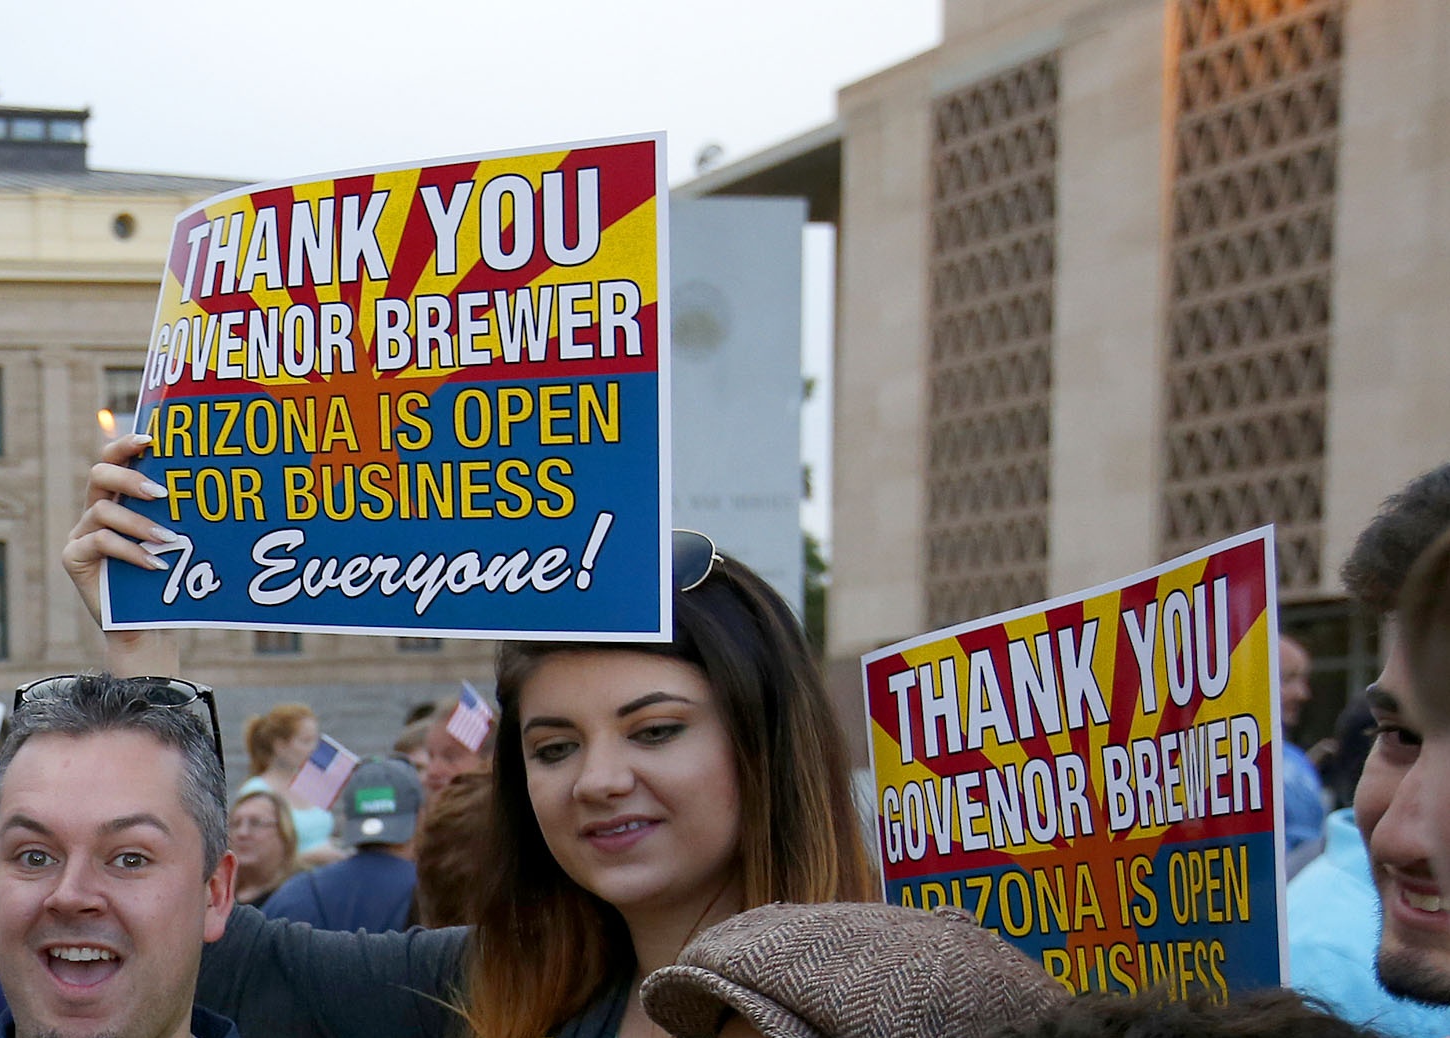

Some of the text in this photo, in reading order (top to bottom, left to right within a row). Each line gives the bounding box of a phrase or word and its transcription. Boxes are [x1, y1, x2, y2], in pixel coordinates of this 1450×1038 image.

[180, 166, 601, 305] THANK YOU
[147, 278, 644, 392] GOVENOR BREWER
[139, 381, 621, 460] ARIZONA IS OPEN
[164, 458, 576, 522] FOR BUSINESS
[139, 511, 614, 617] To Everyone!
[887, 575, 1232, 766] THANK YOU
[882, 713, 1263, 865] GOVENOR BREWER
[1114, 854, 1160, 928] IS
[1167, 844, 1251, 926] OPEN
